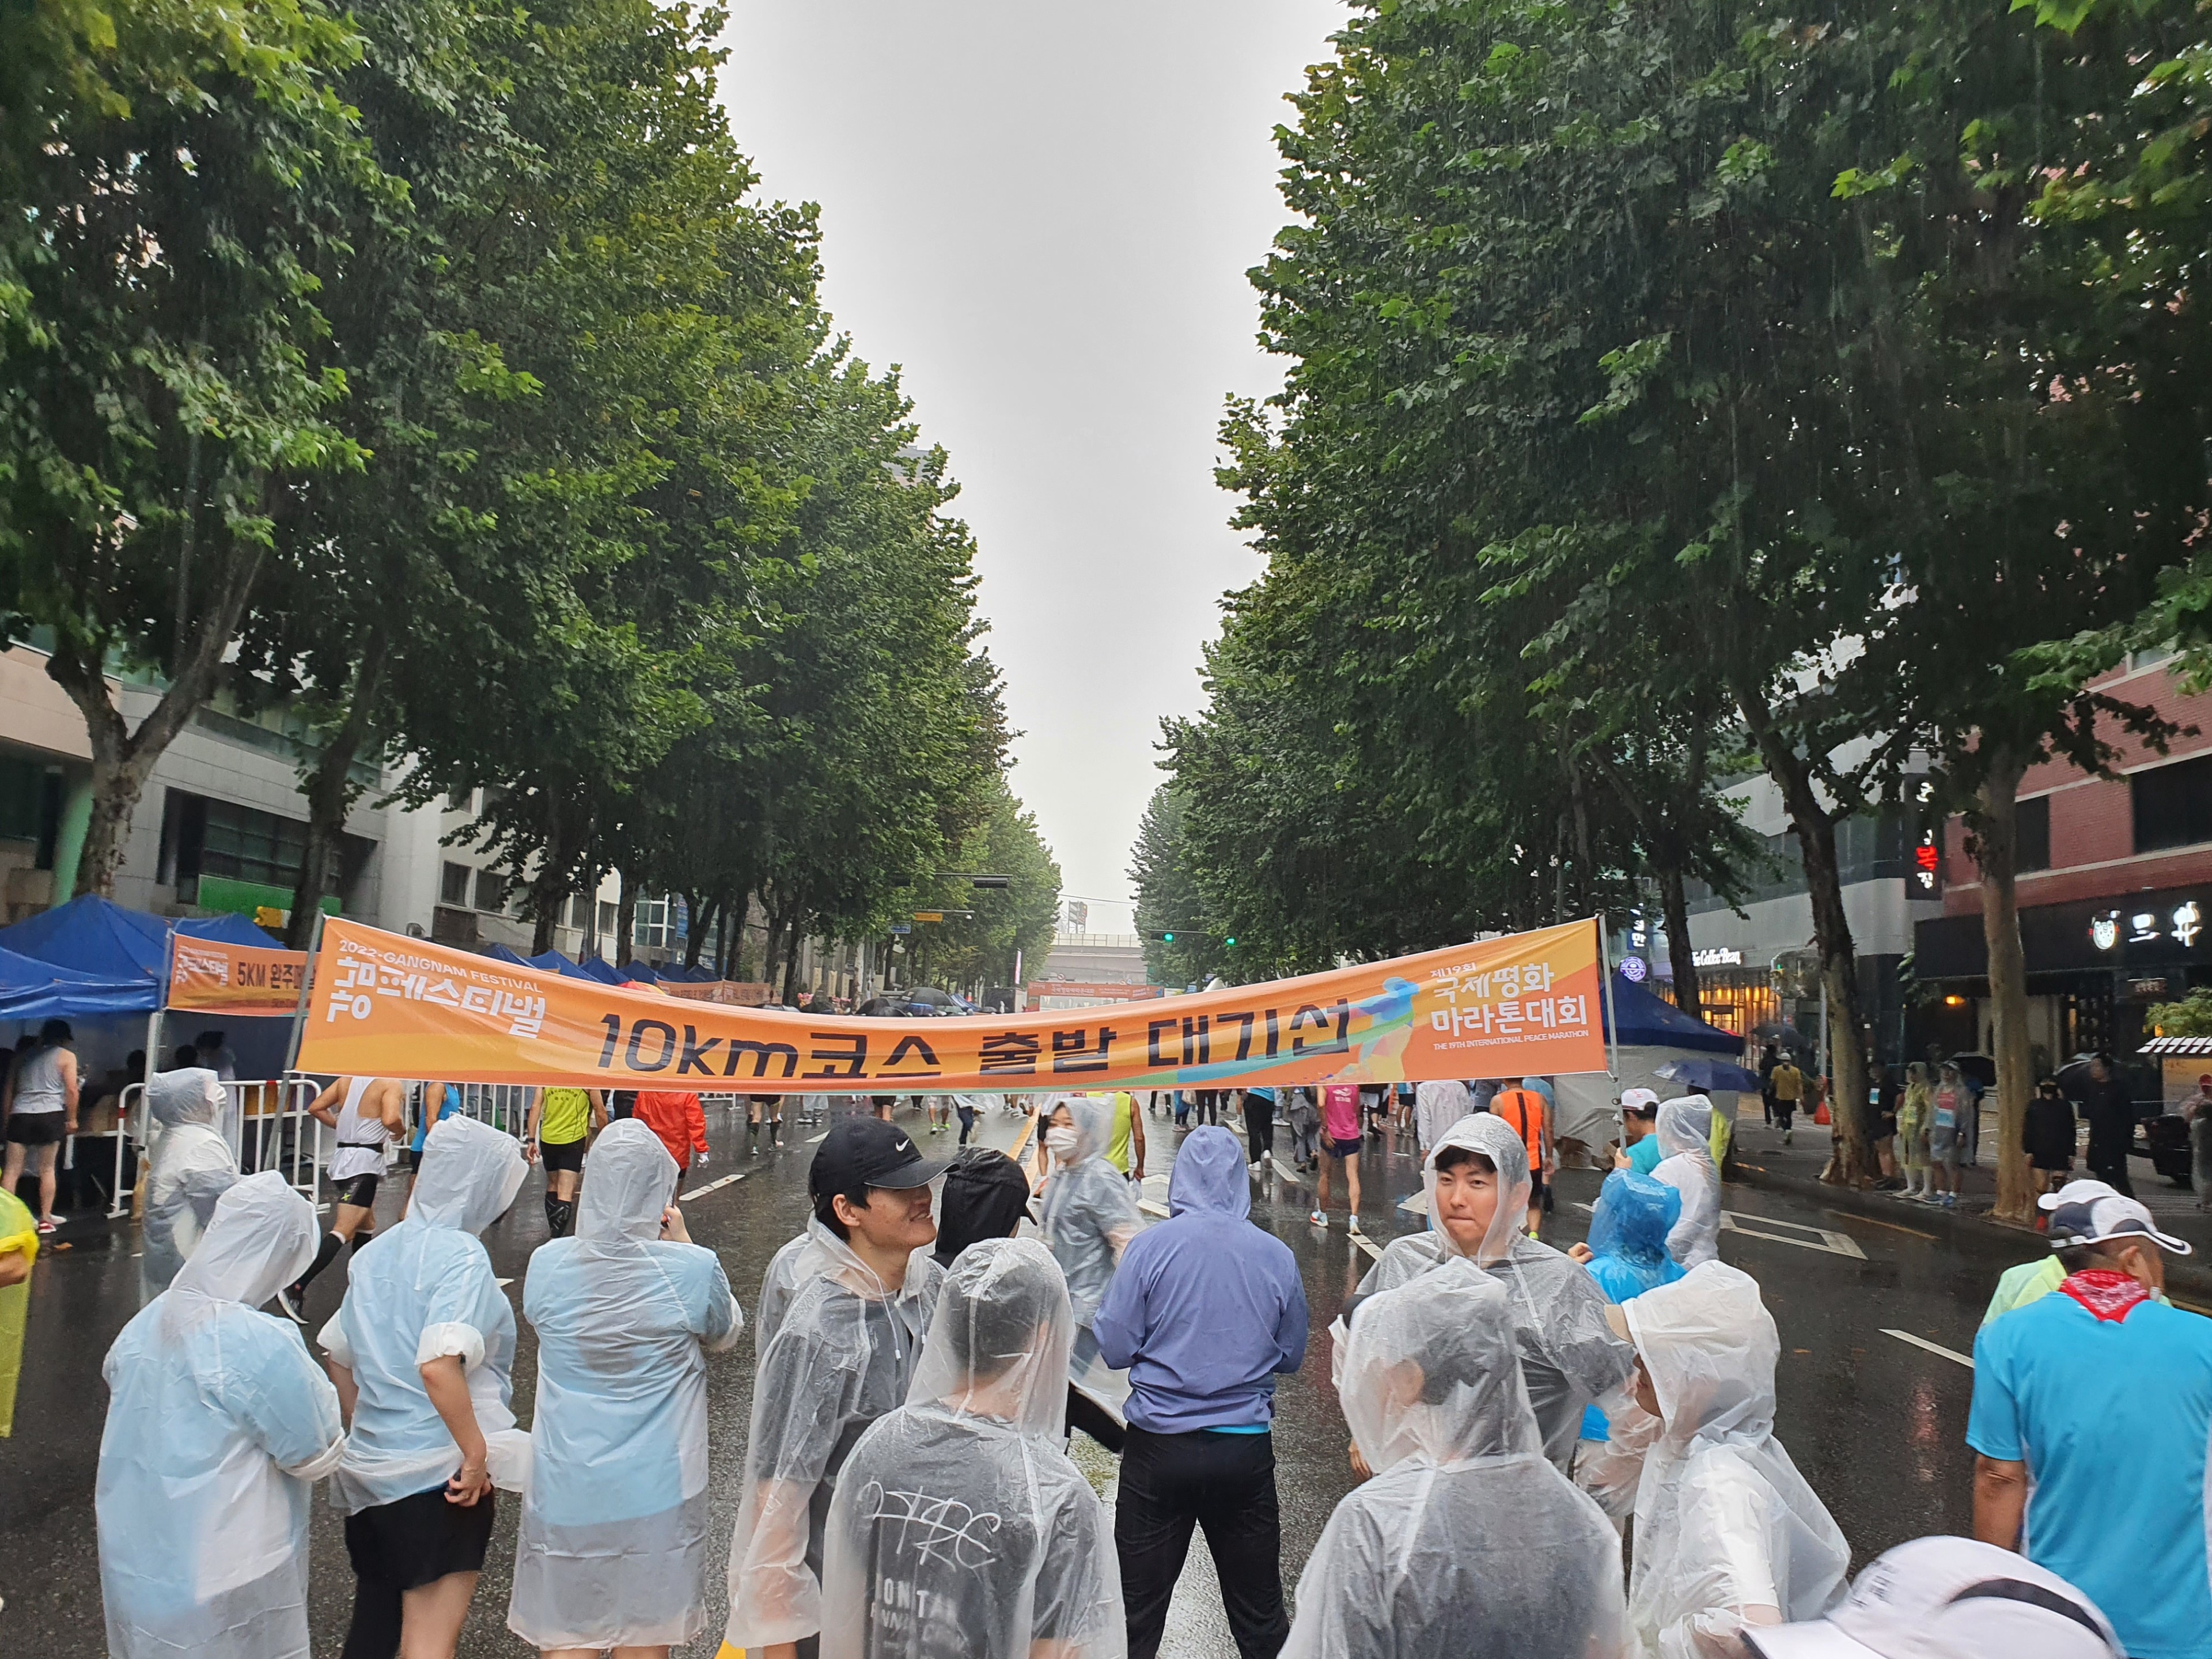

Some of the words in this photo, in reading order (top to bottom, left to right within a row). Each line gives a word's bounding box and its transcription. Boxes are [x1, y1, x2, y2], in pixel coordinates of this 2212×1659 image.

[1700, 949, 1721, 966] Coffee
[1719, 947, 1741, 965] Bean
[238, 961, 266, 987] 5KM
[469, 970, 543, 994] FESTIVAL
[1431, 962, 1477, 978] 제19회
[1434, 962, 1554, 1003] 국제평화
[1431, 995, 1588, 1036] 마라톤대회
[597, 1013, 942, 1078] 10km코스
[978, 1027, 1117, 1076] 출발
[1147, 998, 1350, 1067] 대기선
[1449, 1041, 1465, 1050] 19TH
[1467, 1036, 1523, 1048] INTERNATIONAL
[1524, 1033, 1548, 1043] PEACE
[1548, 1030, 1589, 1040] MARATHON
